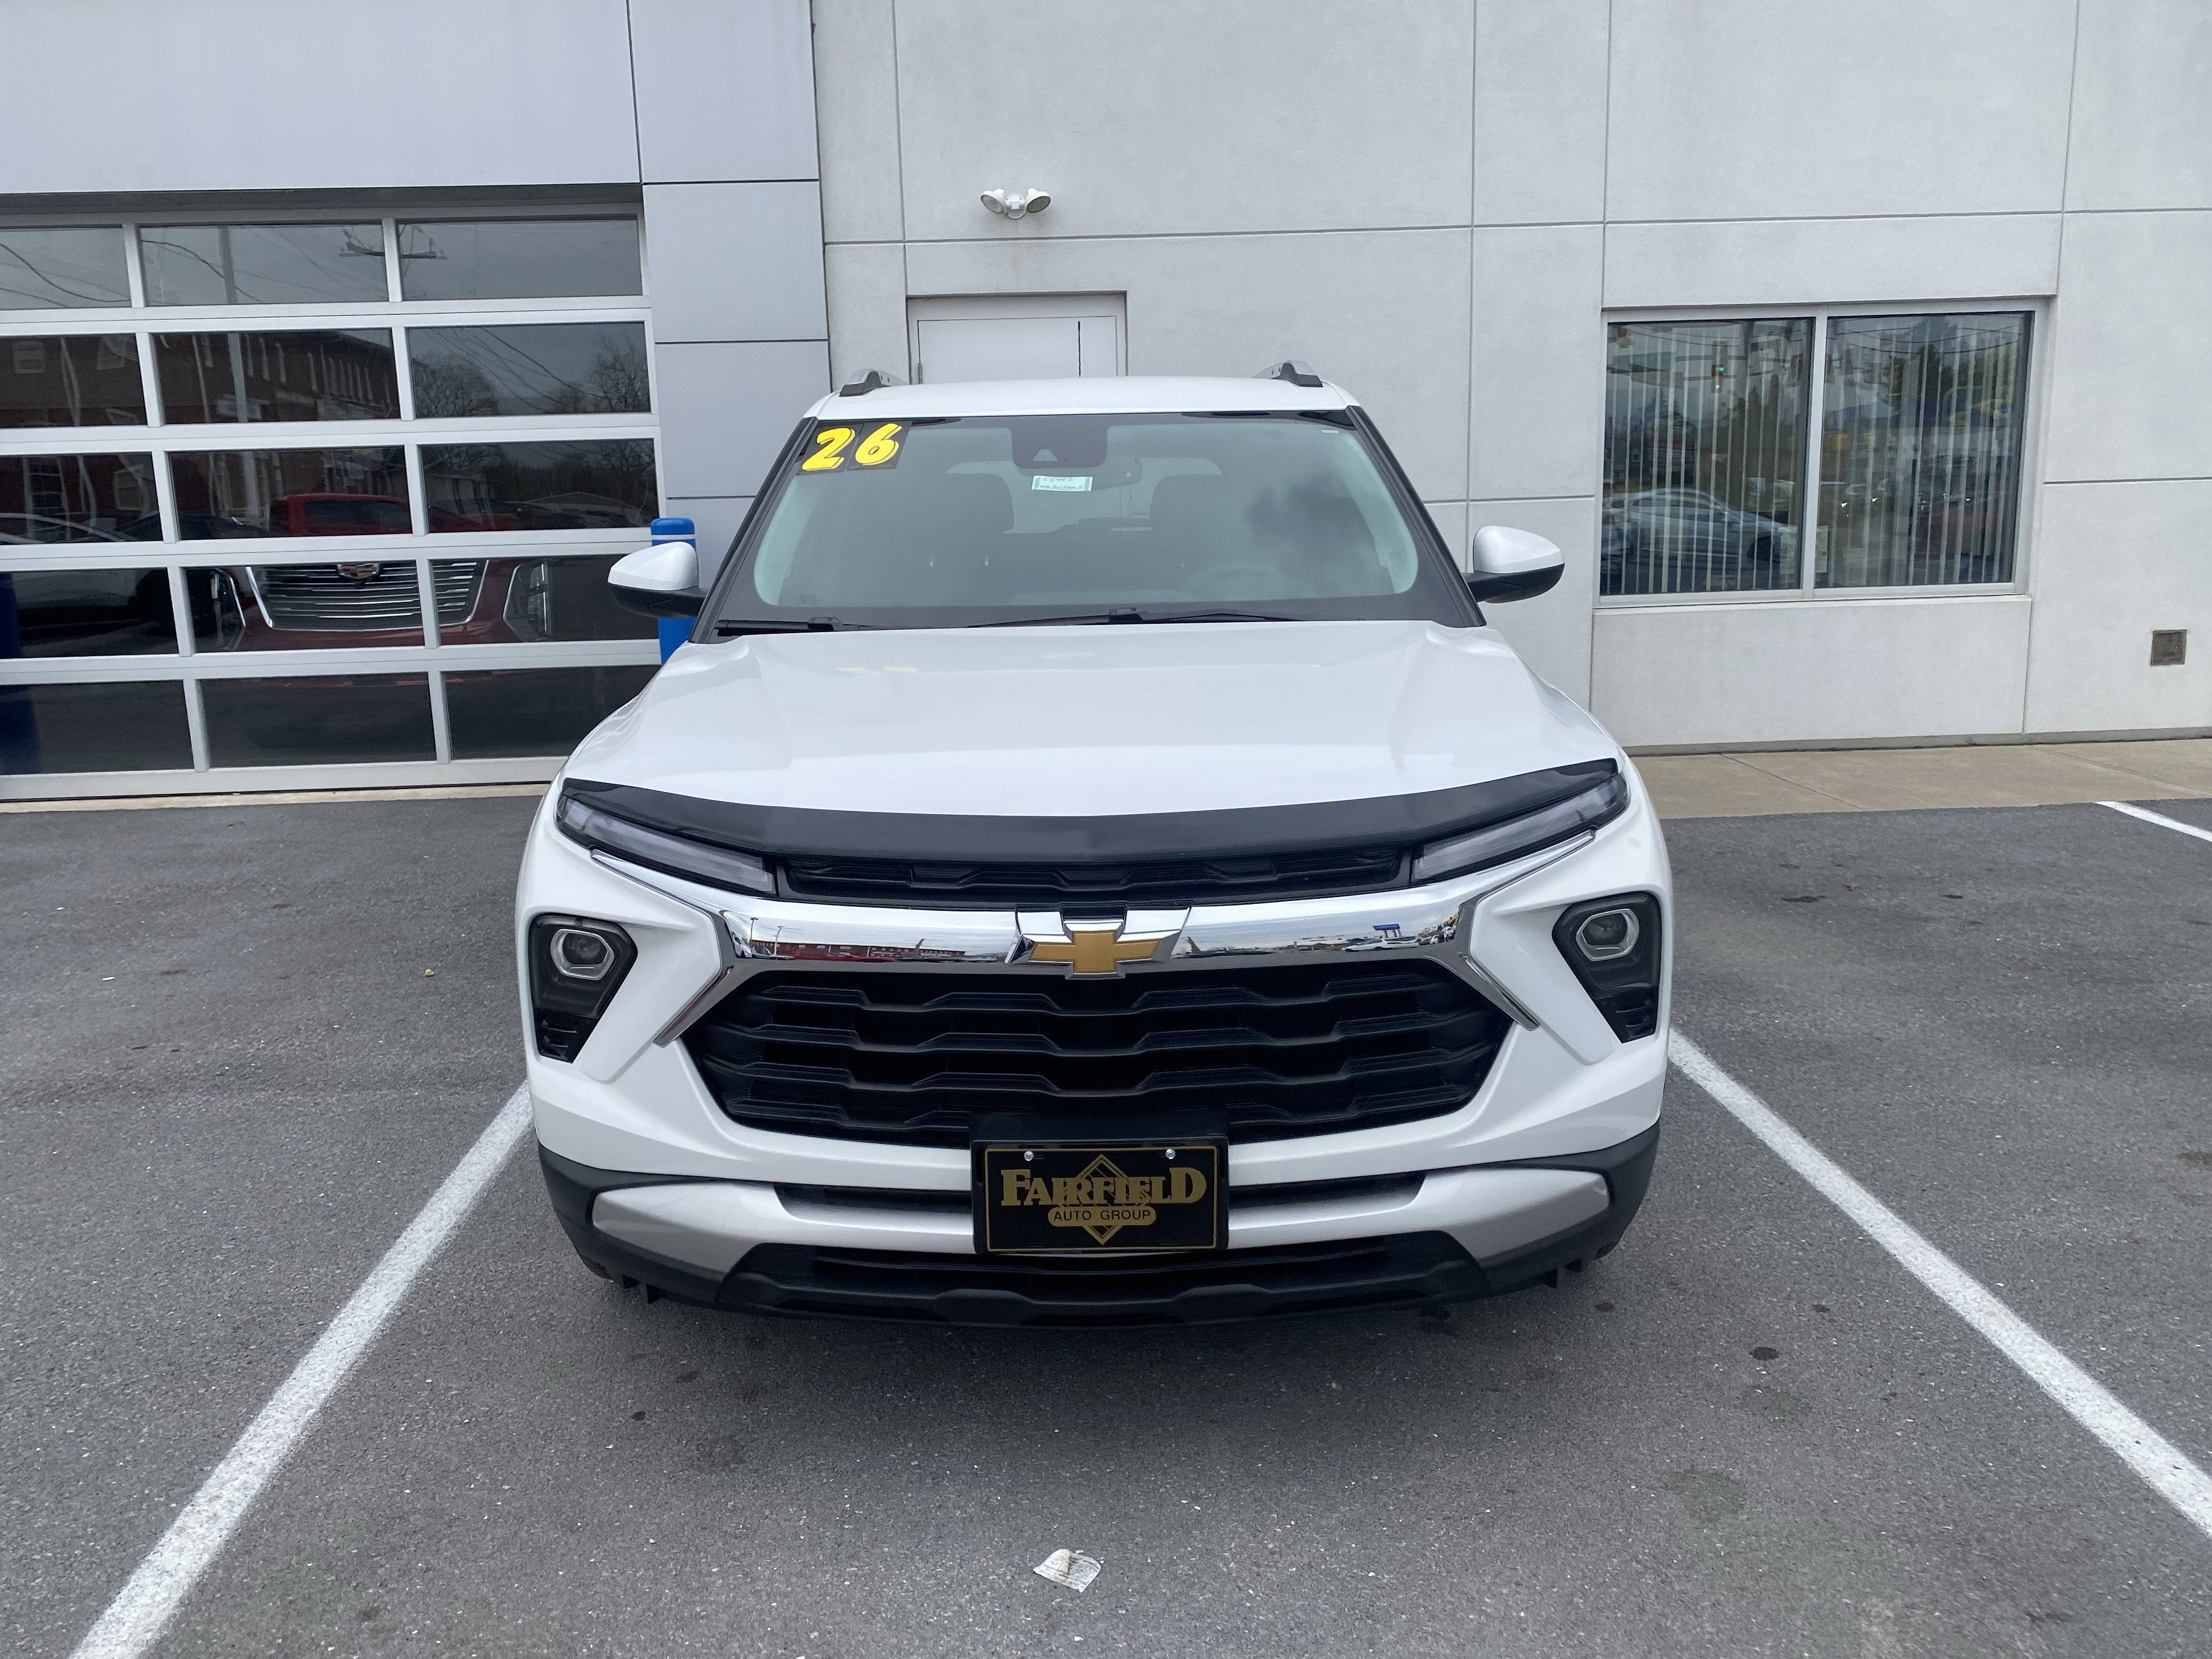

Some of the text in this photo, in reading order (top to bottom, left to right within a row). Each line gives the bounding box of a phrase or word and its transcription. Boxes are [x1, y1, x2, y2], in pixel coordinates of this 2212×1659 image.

[802, 422, 902, 471] 26
[1054, 1210, 1150, 1221] AUTO GROUP
